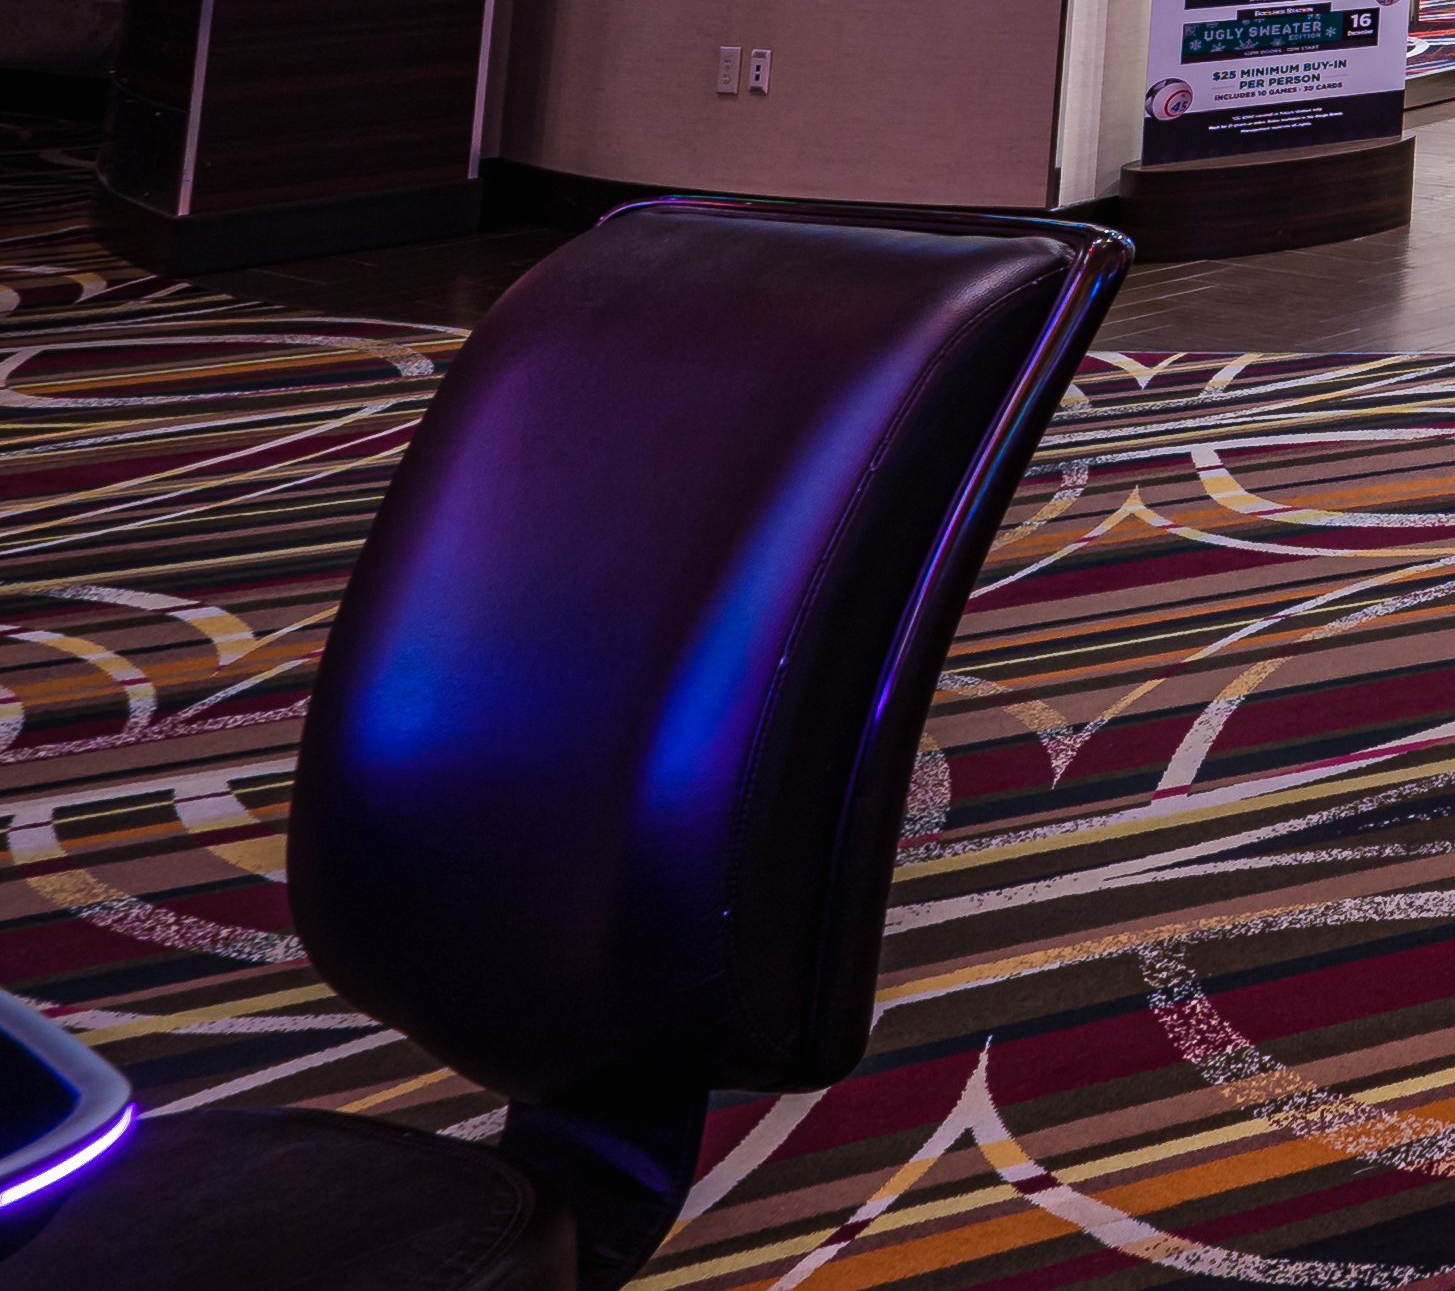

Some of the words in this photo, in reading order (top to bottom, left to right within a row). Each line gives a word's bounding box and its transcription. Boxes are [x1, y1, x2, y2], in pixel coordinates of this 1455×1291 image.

[1212, 71, 1237, 82] $25
[1240, 63, 1300, 79] MINIMUM
[1303, 59, 1347, 72] BUY-IN
[1239, 78, 1265, 90] PER
[1268, 73, 1321, 86] PERSON
